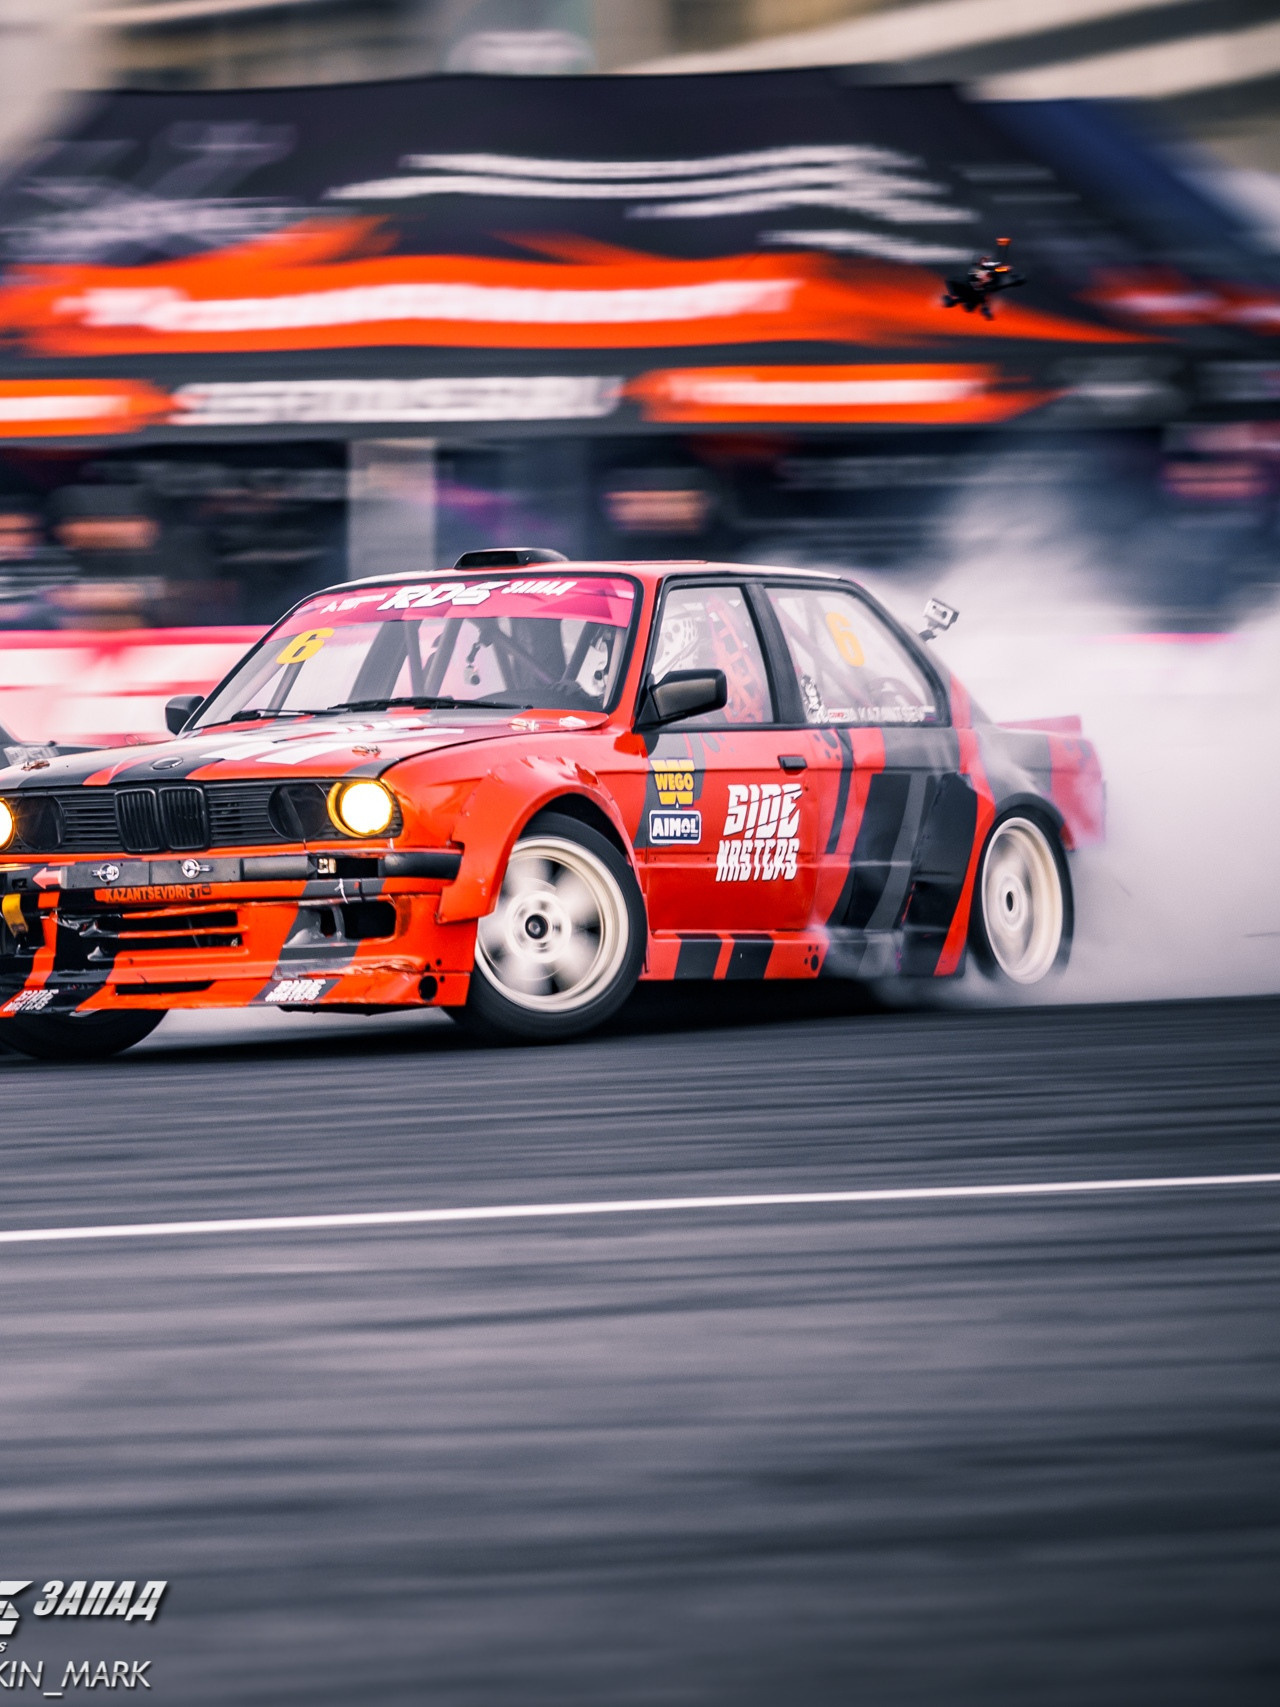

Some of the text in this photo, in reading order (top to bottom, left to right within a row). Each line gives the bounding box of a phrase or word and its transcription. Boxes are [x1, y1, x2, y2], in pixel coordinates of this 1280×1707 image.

[376, 581, 510, 610] RDS
[276, 628, 334, 665] 6
[825, 611, 866, 668] 6
[654, 773, 694, 791] WEGO
[652, 816, 699, 837] AIMOL
[723, 783, 803, 839] SIDE
[715, 837, 801, 882] MASTERS
